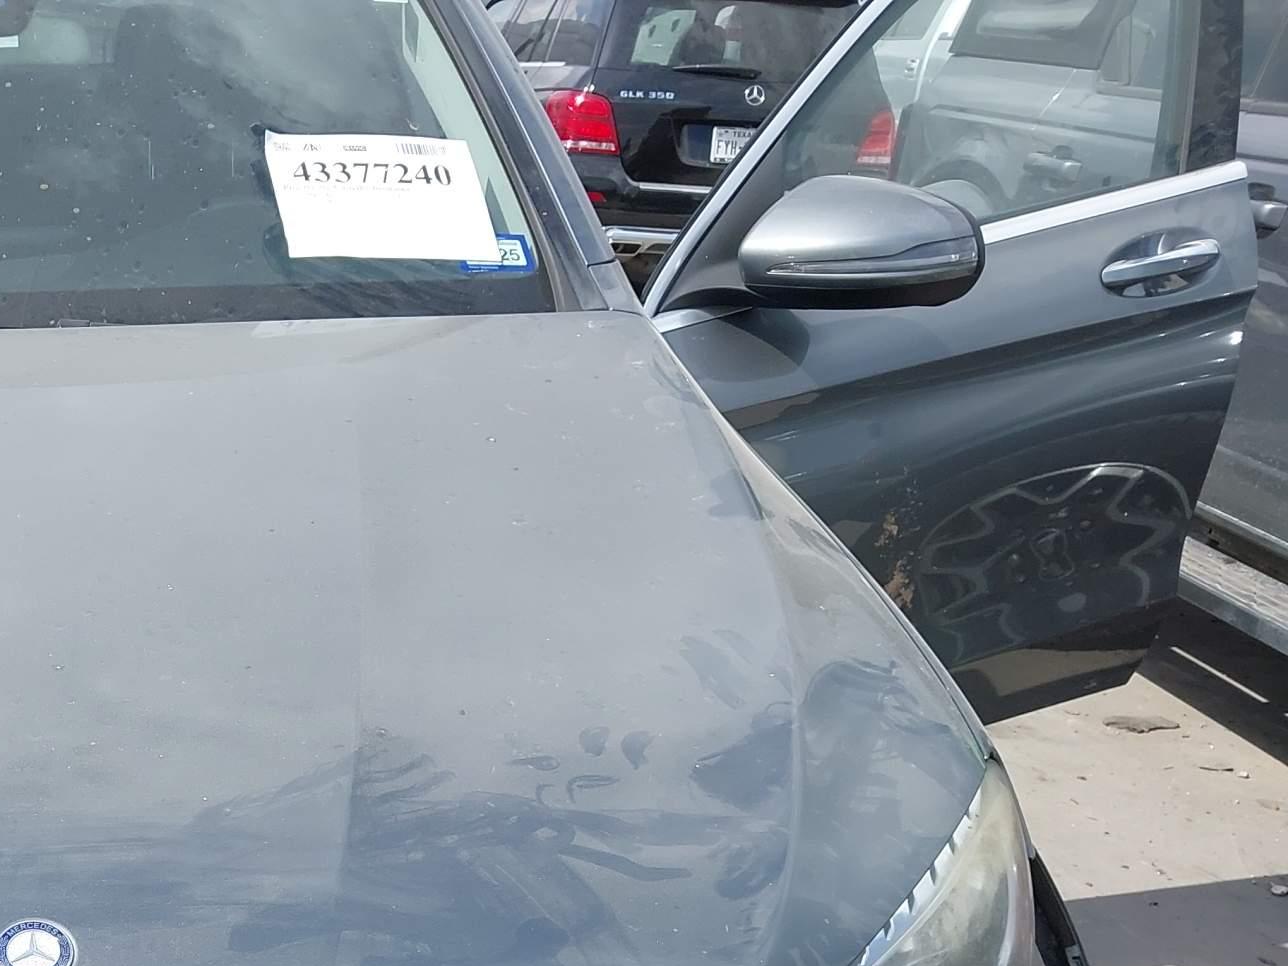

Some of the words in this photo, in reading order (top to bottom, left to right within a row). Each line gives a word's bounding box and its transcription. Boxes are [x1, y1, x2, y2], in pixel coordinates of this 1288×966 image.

[619, 90, 644, 98] GLK
[648, 91, 675, 100] 350
[731, 130, 753, 138] TEXA
[716, 139, 743, 156] FYH-
[293, 161, 452, 186] 43377240
[6, 921, 59, 937] MERCEDES
